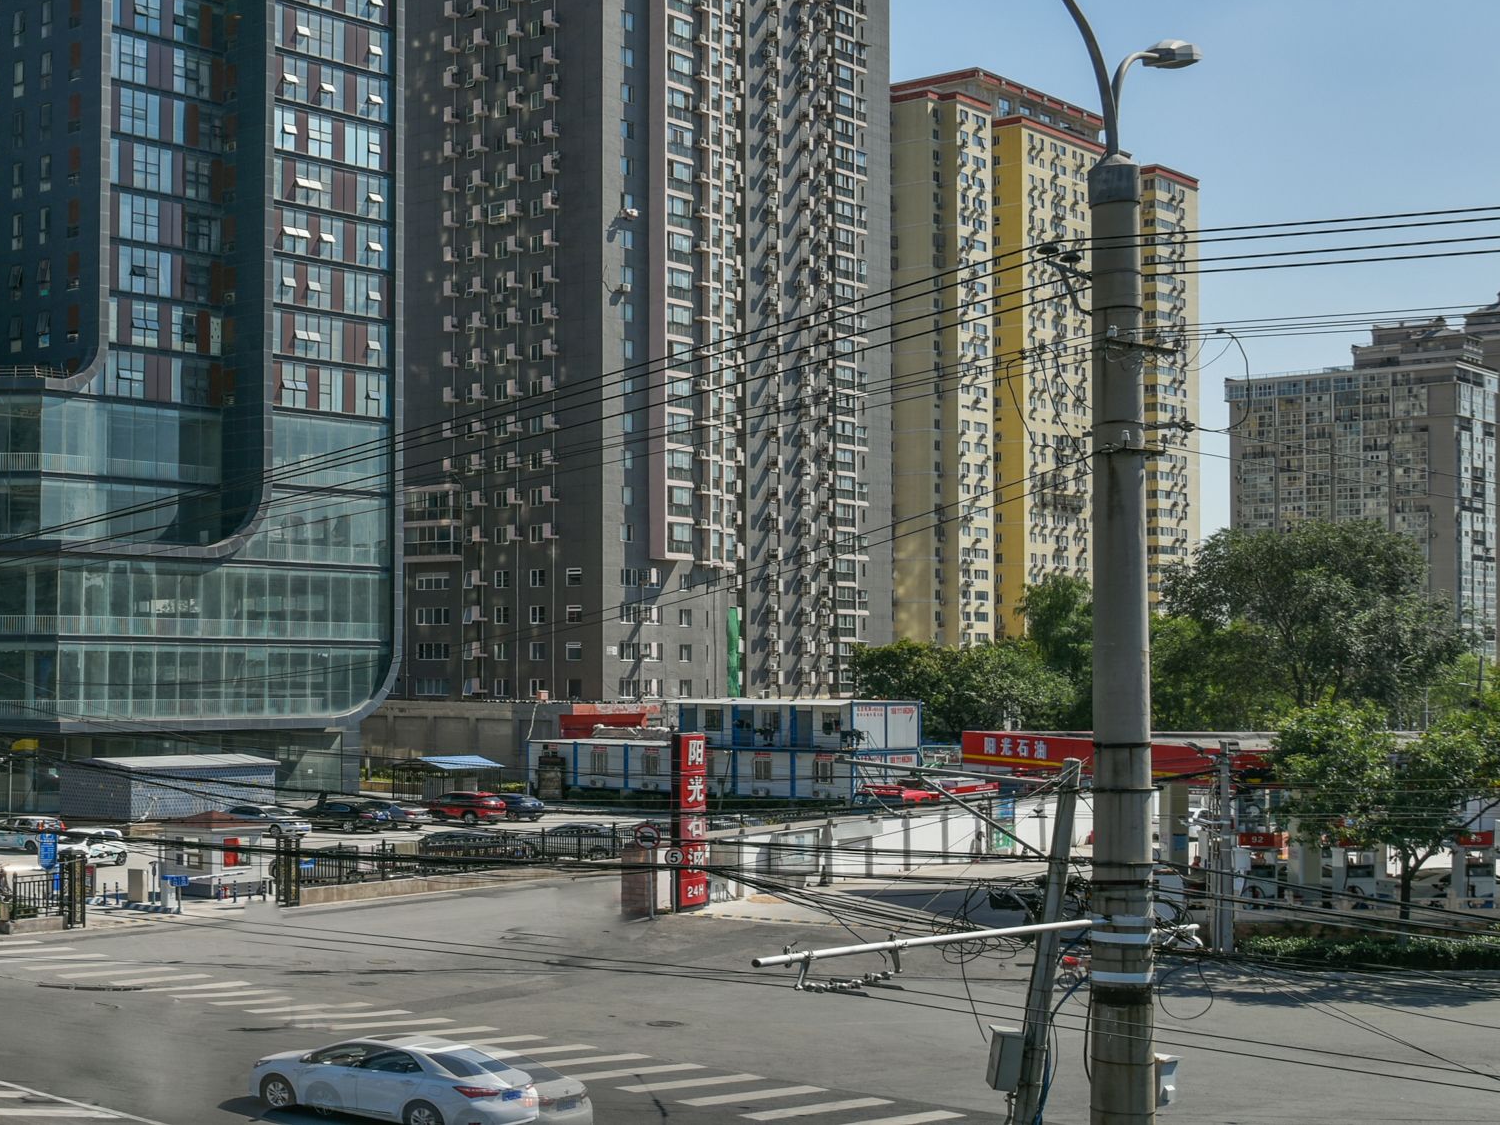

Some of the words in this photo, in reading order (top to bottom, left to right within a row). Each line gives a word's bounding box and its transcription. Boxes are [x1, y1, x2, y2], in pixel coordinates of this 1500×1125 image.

[983, 736, 1047, 760] 阳光石油
[1251, 835, 1264, 843] 92
[670, 852, 678, 862] 5
[687, 884, 704, 898] 24H
